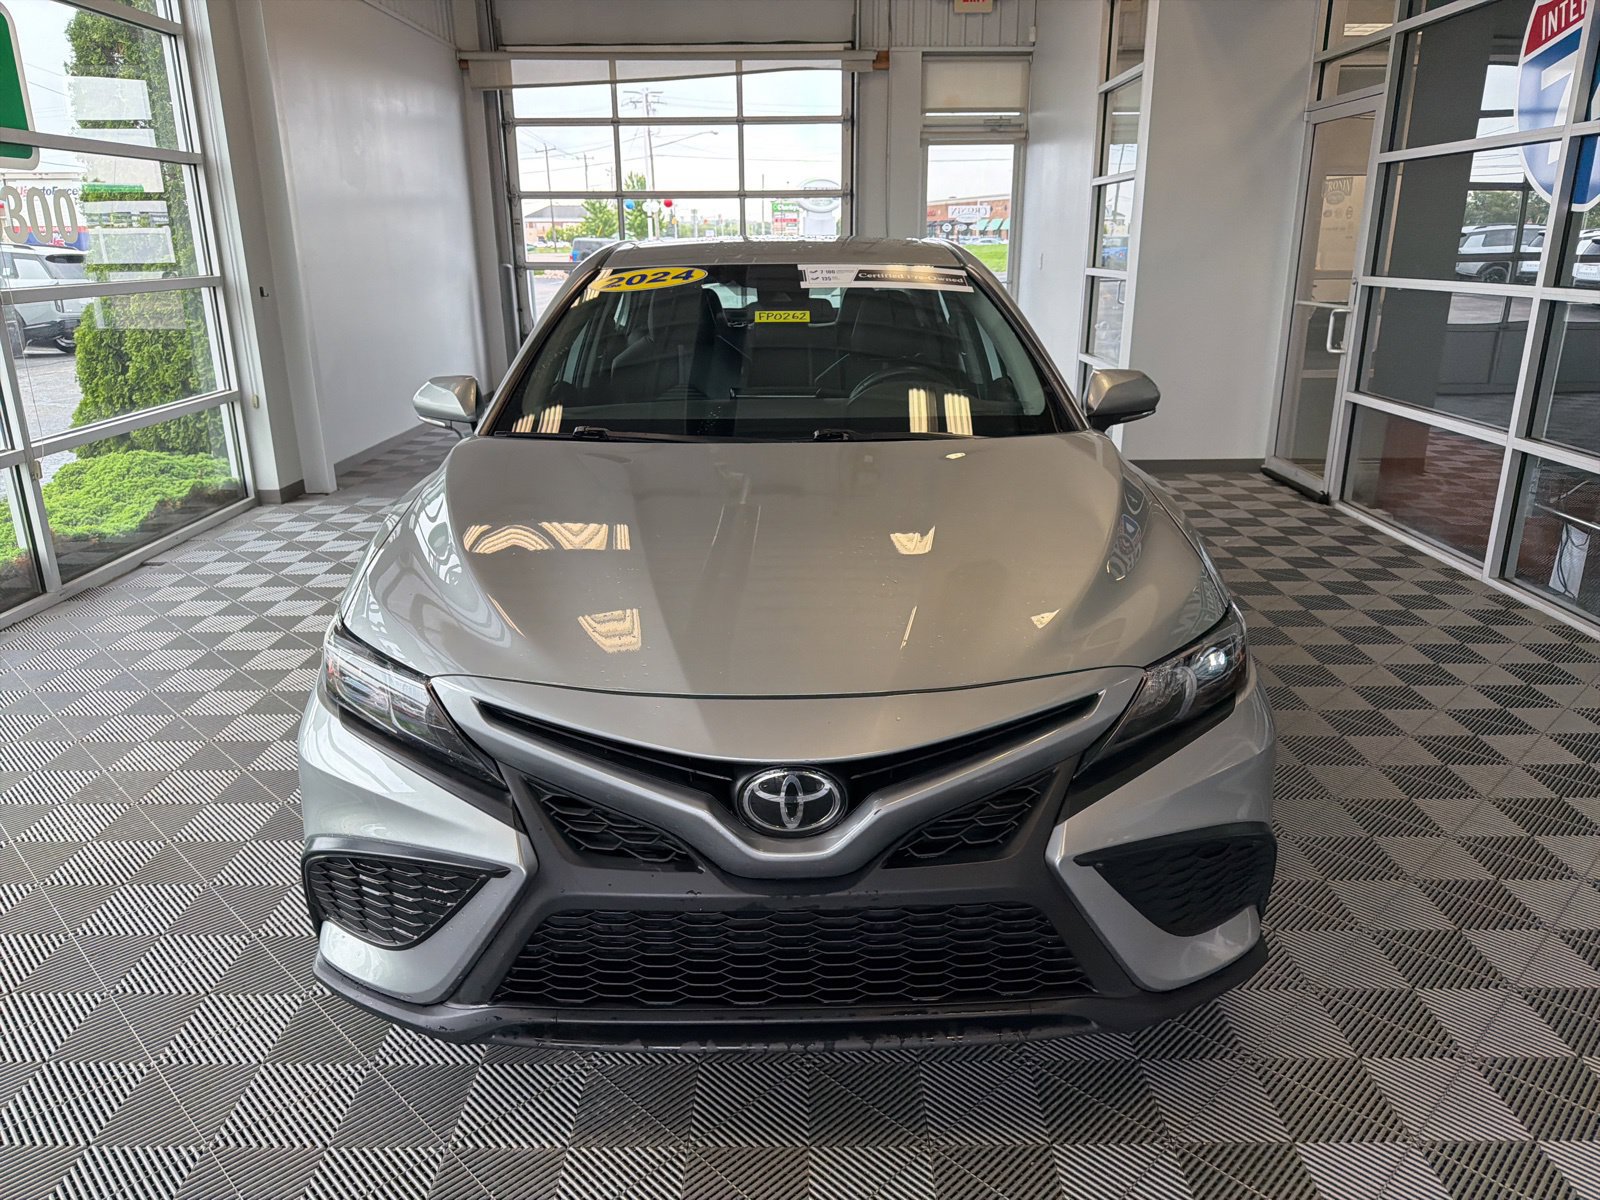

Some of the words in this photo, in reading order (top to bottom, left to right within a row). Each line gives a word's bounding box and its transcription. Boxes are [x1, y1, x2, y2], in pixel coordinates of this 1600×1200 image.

[0, 185, 79, 244] 300
[601, 269, 695, 288] 2024
[858, 271, 905, 280] Certified
